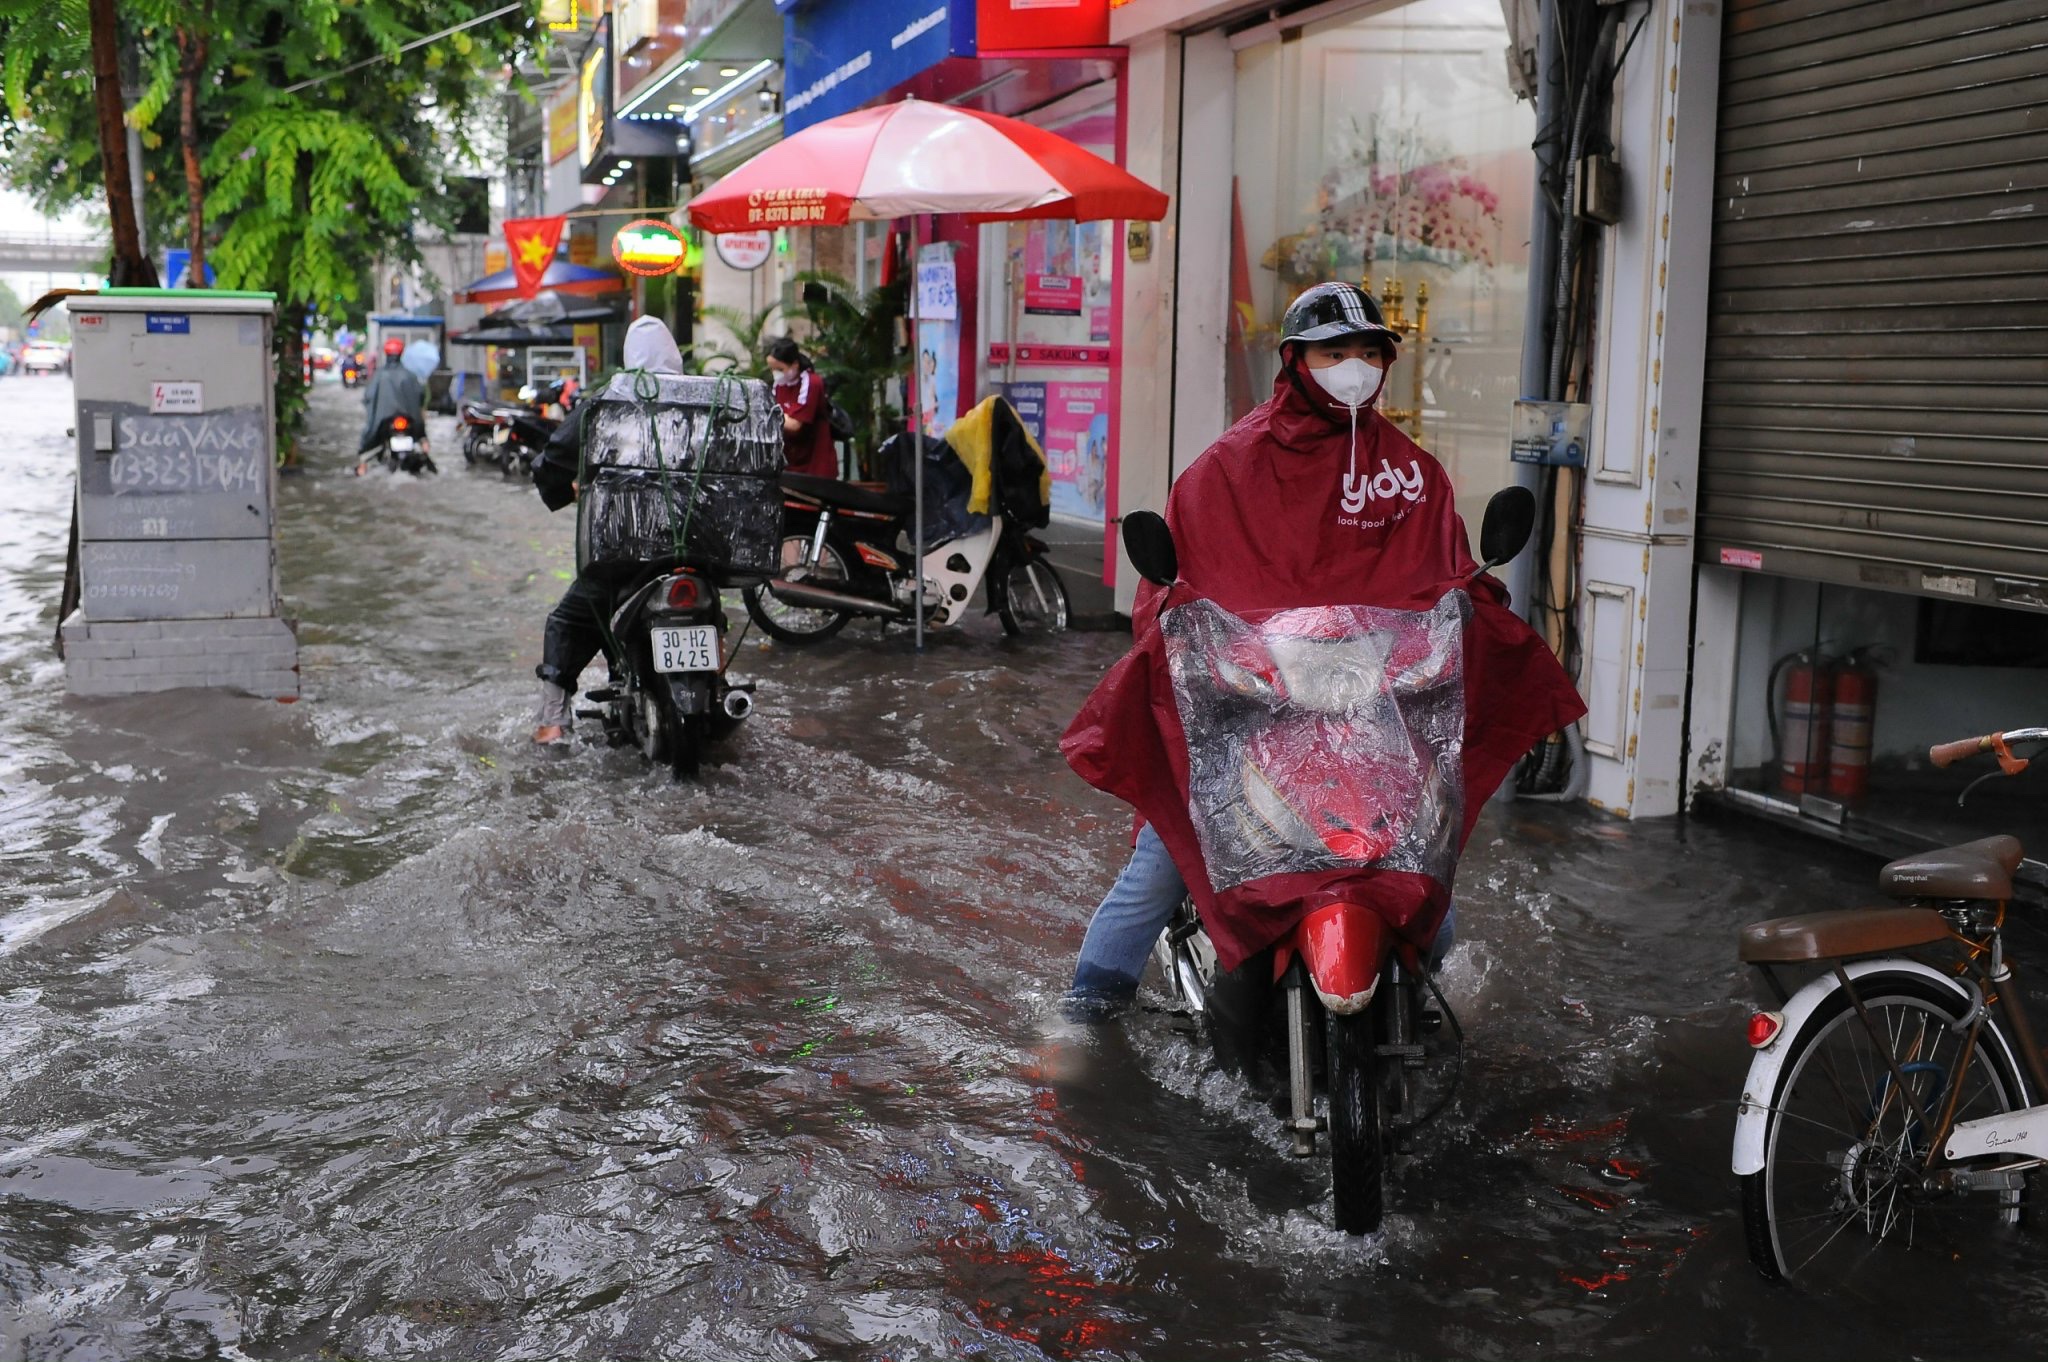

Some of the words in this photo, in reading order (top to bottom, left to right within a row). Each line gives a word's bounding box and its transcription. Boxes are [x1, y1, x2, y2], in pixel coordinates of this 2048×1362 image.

[1040, 349, 1089, 361] SAKUKO
[1338, 516, 1359, 526] look
[1361, 517, 1385, 529] good
[662, 630, 708, 648] 30-H2
[664, 650, 710, 668] 8425
